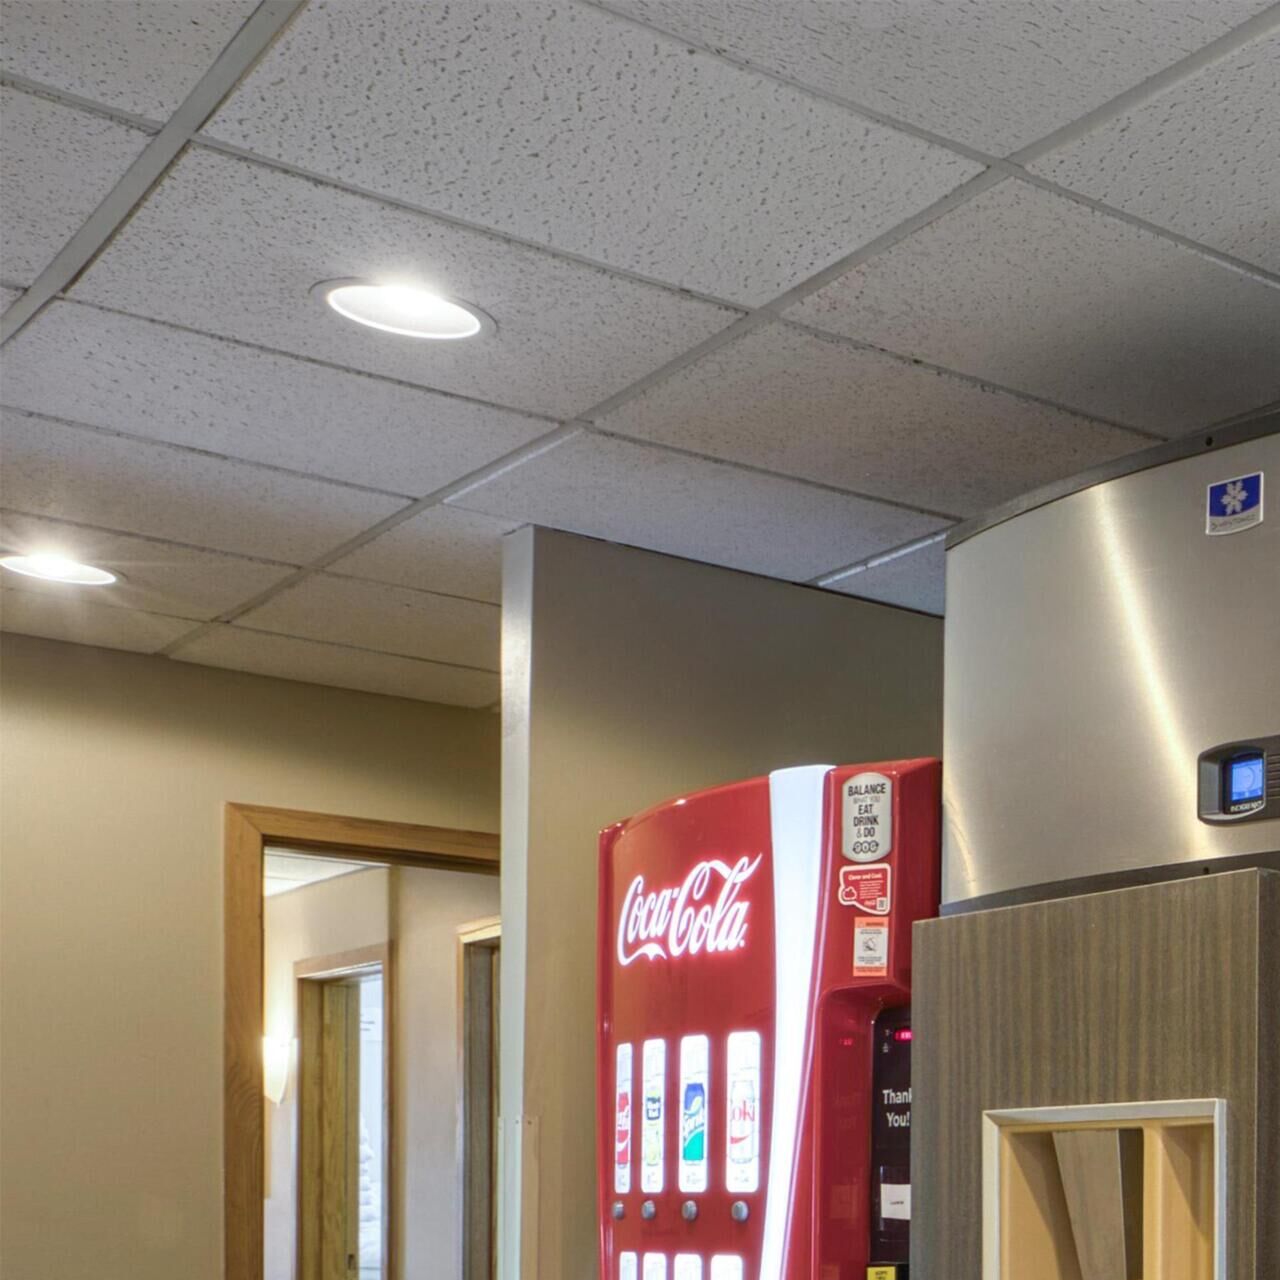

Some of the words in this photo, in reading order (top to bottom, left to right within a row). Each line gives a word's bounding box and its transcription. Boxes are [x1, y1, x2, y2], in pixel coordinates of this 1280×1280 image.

[848, 783, 886, 796] BALANCE
[858, 804, 873, 815] EAT
[853, 815, 879, 827] DRINK
[863, 827, 876, 837] DO
[617, 853, 762, 966] Coca-Cola
[886, 1111, 910, 1127] You!
